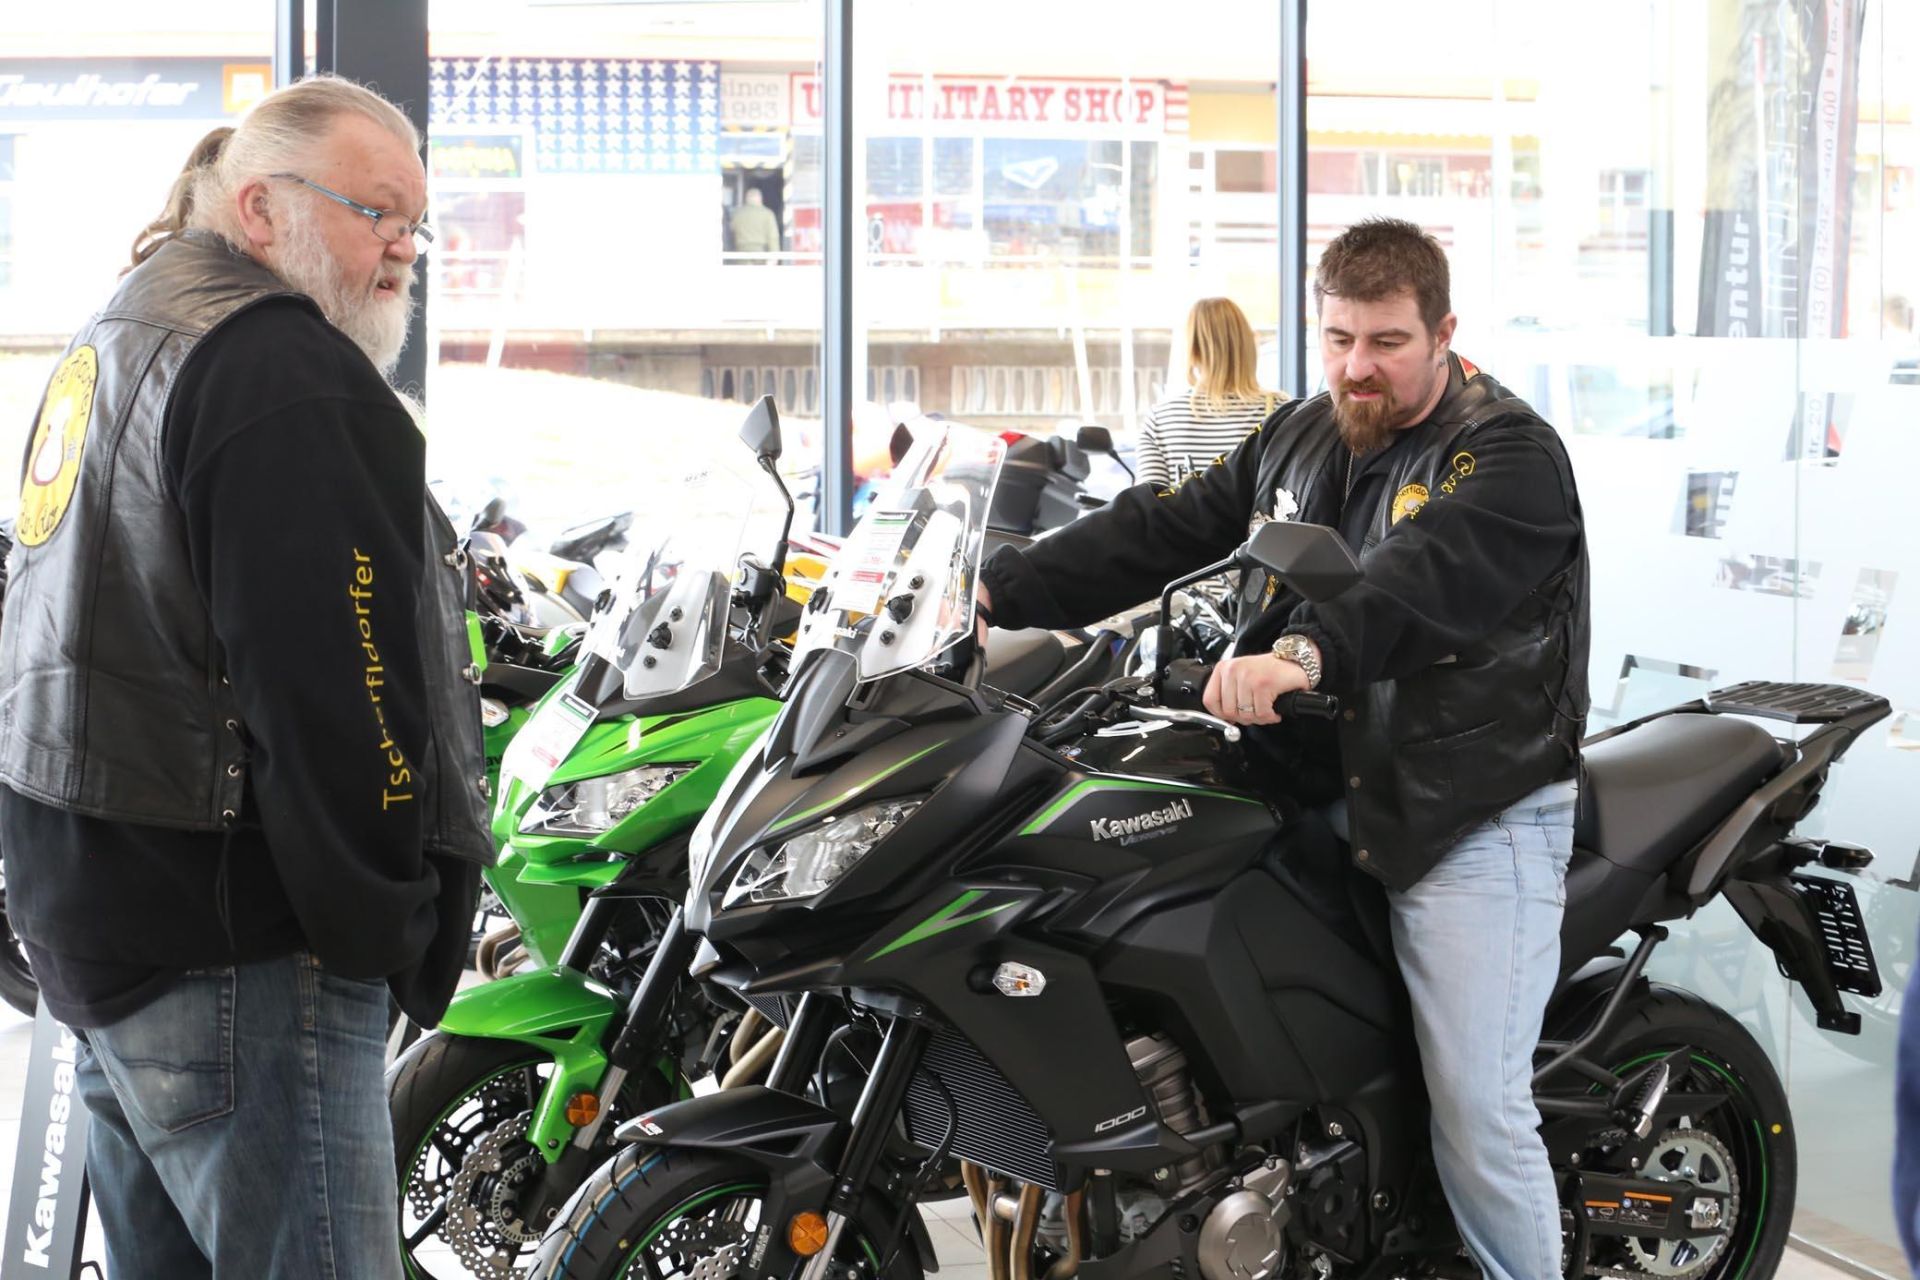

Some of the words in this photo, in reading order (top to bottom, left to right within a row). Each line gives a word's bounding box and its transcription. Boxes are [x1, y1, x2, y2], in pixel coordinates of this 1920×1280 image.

[1090, 798, 1193, 842] Kawasaki
[1094, 1105, 1146, 1133] 1000
[23, 1021, 77, 1268] Kawasak
